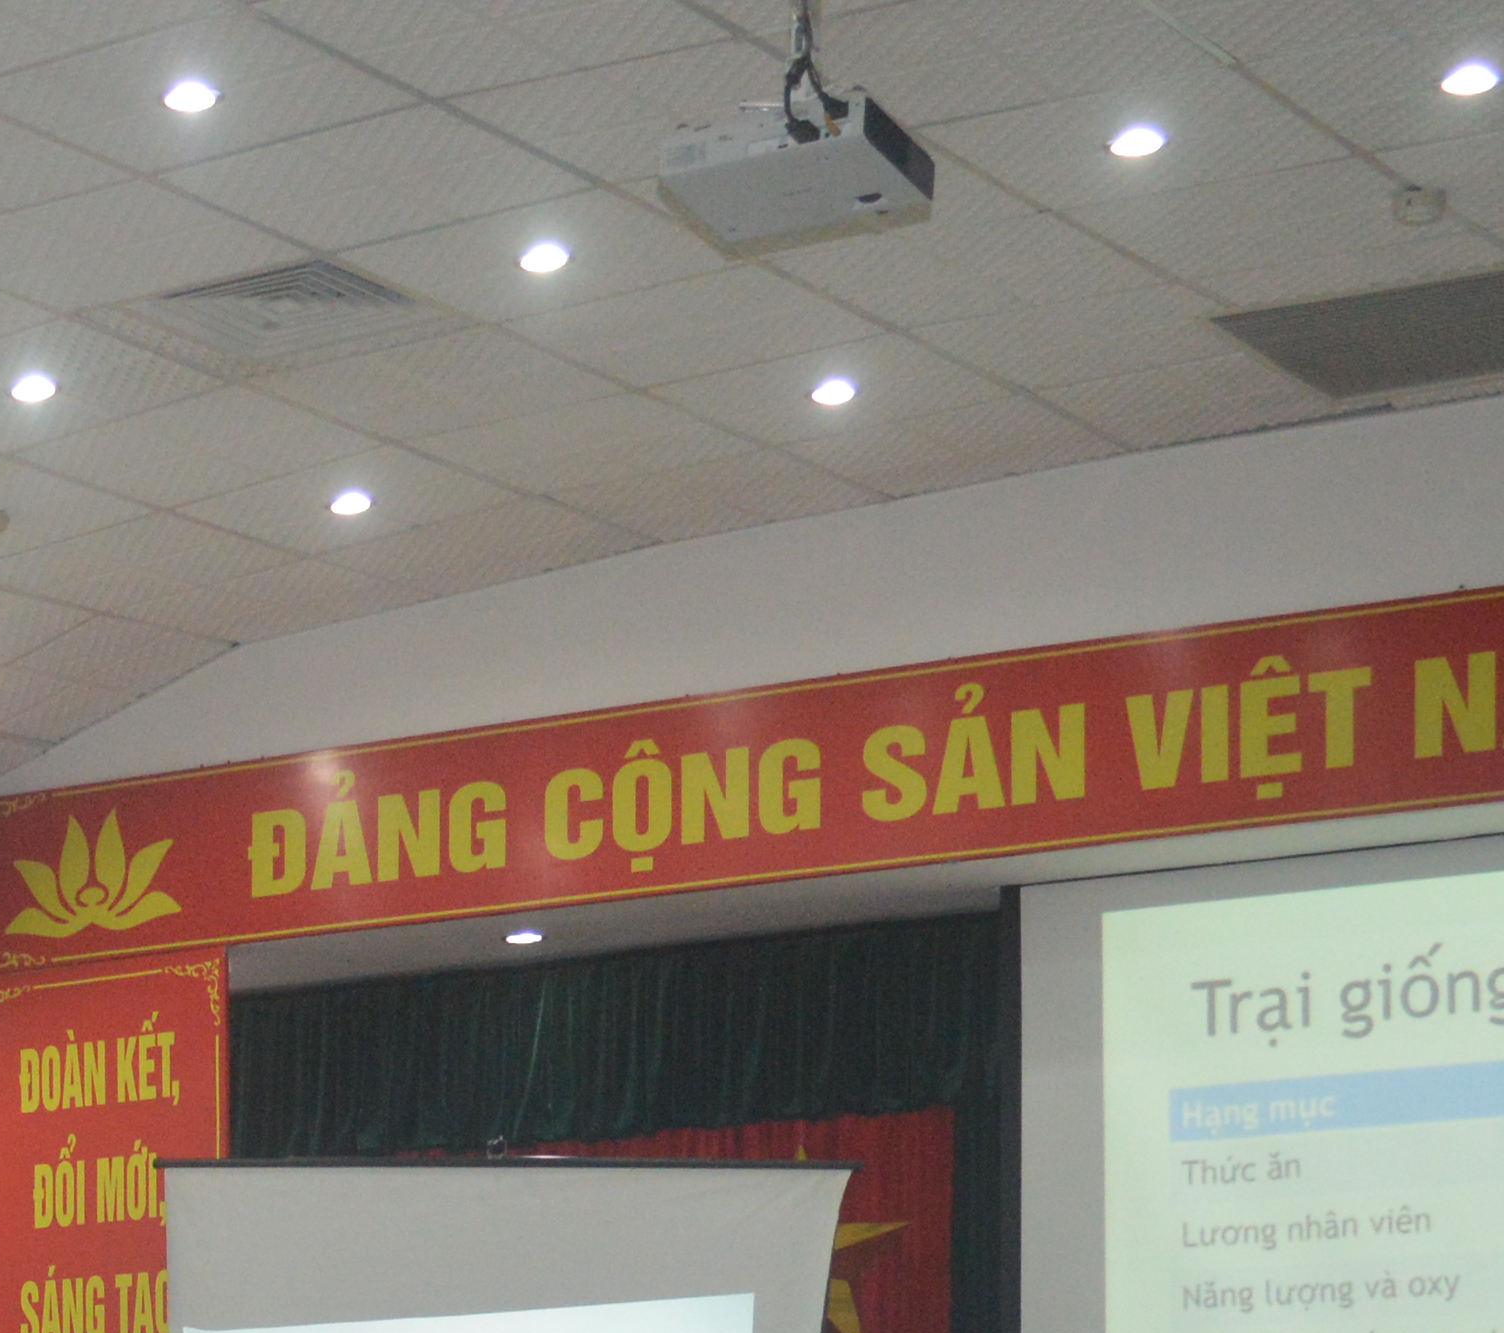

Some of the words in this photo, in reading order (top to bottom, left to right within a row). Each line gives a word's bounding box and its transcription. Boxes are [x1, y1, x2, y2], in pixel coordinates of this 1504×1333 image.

[248, 769, 507, 898] ĐẢNG
[543, 740, 822, 874] CỘNG
[861, 684, 1086, 819] SẢN
[1127, 655, 1373, 800] VIỆT
[1191, 971, 1311, 1047] Trại
[19, 1029, 106, 1113] ĐOÀN
[117, 1011, 180, 1105] KẾT,
[1181, 1098, 1259, 1135] Hạng
[1270, 1094, 1337, 1127] mục
[33, 1133, 85, 1229] ĐỔI
[97, 1139, 166, 1226] MỚI,
[1182, 1152, 1257, 1186] Thức
[1266, 1154, 1301, 1180] ăn
[1182, 1216, 1277, 1251] Lương
[1287, 1210, 1358, 1243] nhân
[1371, 1205, 1432, 1235] viên
[1182, 1281, 1253, 1313] Năng
[1266, 1279, 1353, 1311] lượng
[1365, 1273, 1397, 1300] và
[1407, 1271, 1460, 1302] oxy
